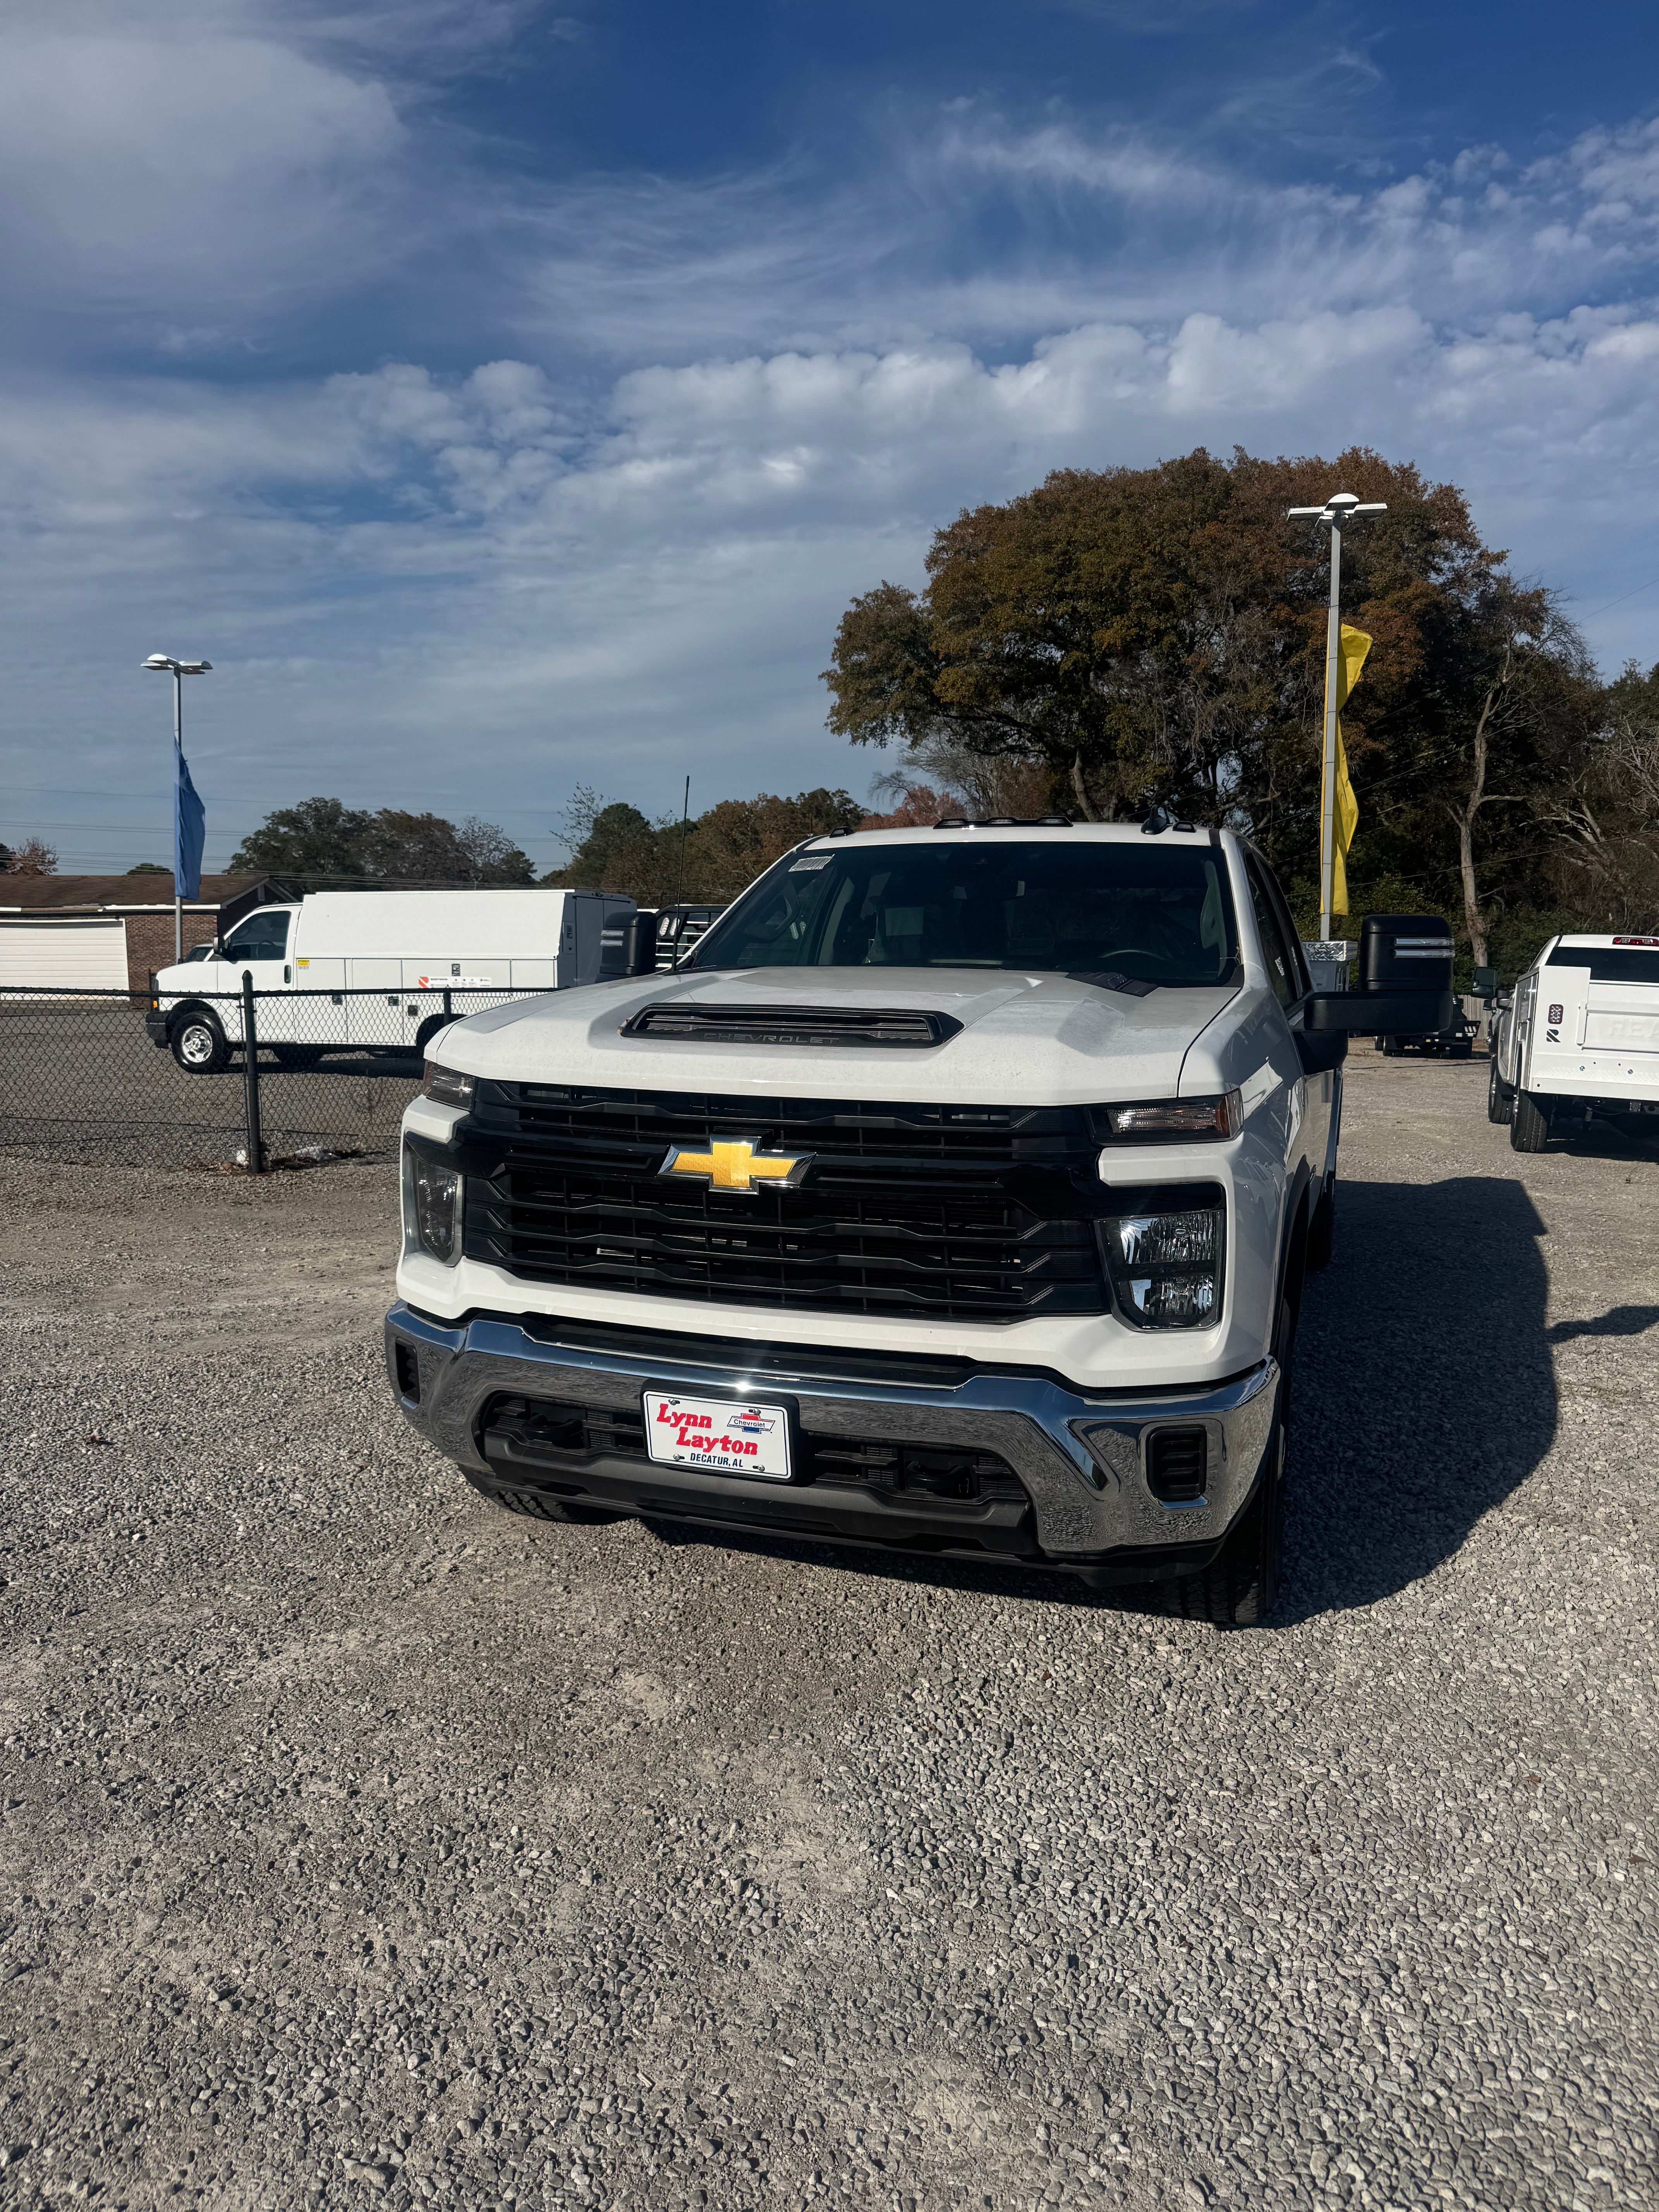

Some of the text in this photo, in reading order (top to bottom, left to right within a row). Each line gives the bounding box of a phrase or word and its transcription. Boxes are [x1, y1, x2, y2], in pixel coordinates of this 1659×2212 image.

[702, 1033, 840, 1044] CHEVROLET
[656, 1403, 712, 1429] Lynn
[733, 1419, 766, 1428] Chevrolet
[676, 1427, 758, 1455] Layton
[690, 1453, 744, 1467] DECATUR, AL
